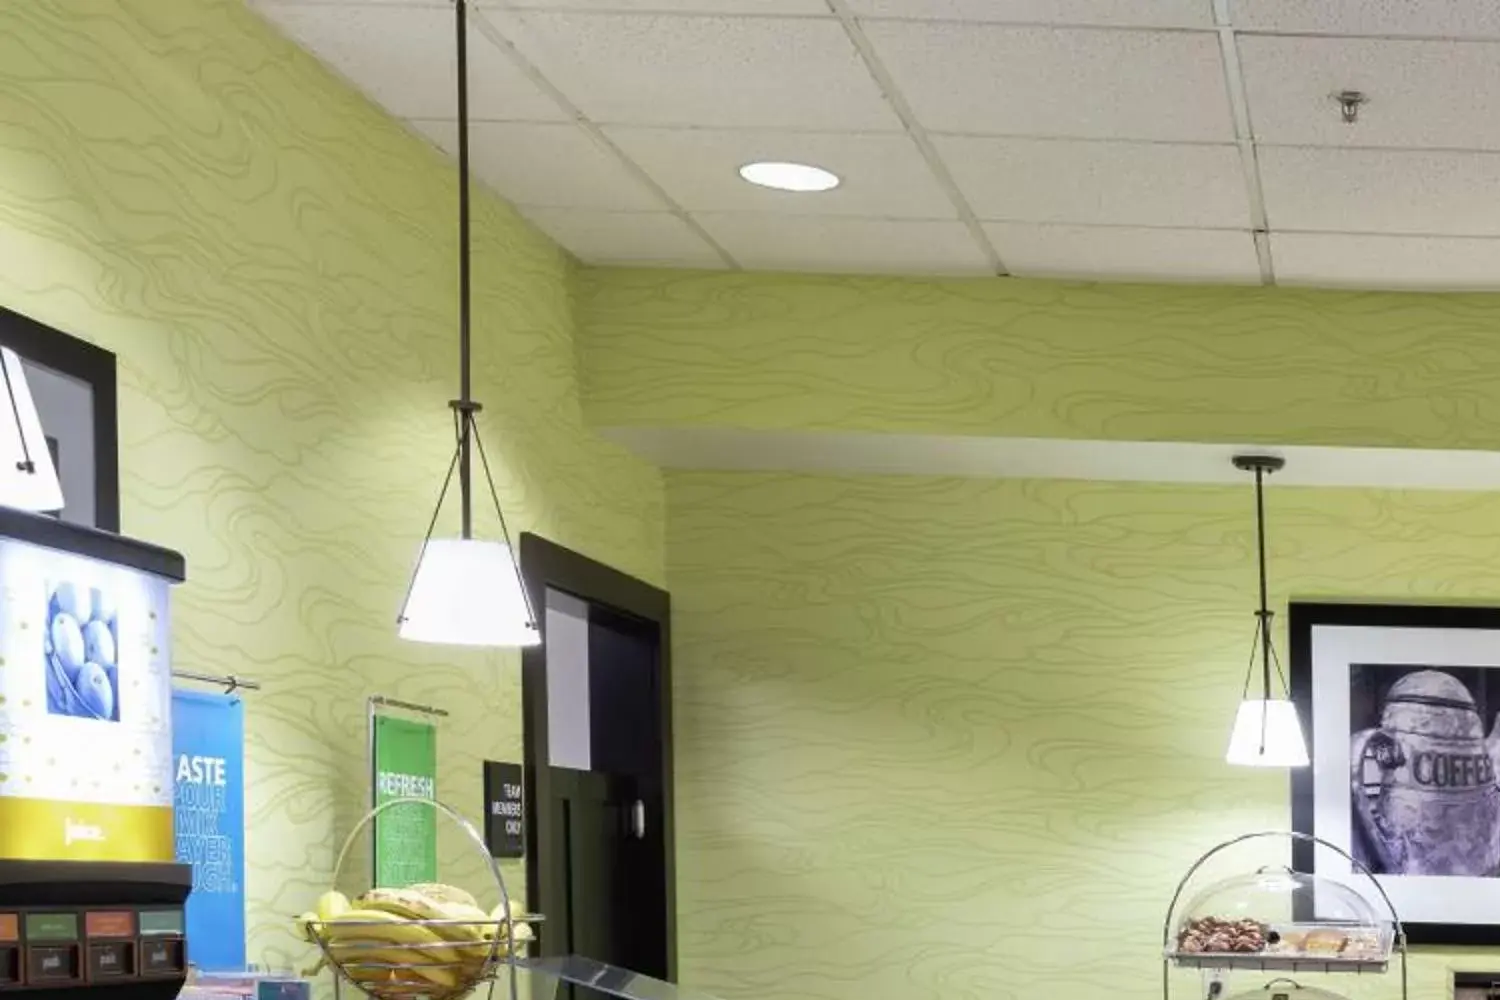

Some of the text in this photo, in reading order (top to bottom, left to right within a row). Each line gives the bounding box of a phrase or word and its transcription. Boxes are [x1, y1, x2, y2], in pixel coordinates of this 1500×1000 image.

[176, 753, 226, 787] ASTE
[379, 772, 434, 799] REFRESH
[1412, 752, 1492, 787] COFFEE
